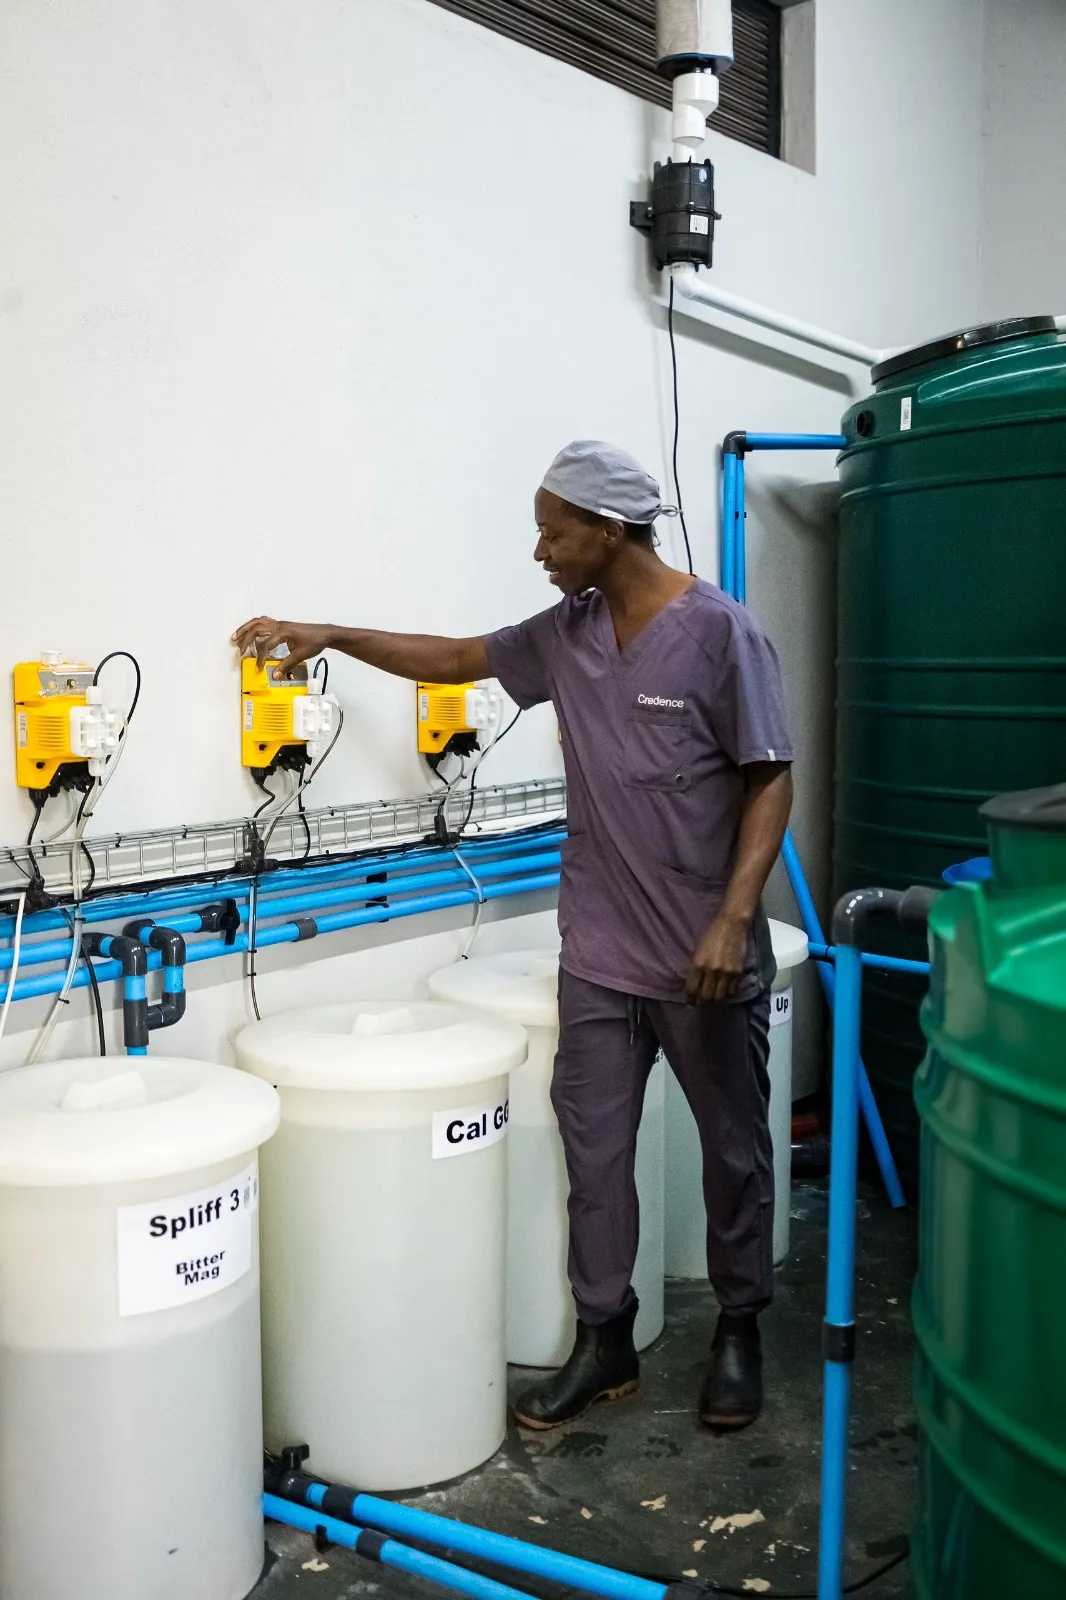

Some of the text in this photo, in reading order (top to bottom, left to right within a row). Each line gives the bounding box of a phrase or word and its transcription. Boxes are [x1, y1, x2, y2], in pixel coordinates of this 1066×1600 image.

[638, 694, 684, 708] Credence
[776, 996, 789, 1014] Up
[446, 1112, 487, 1144] Cal
[149, 1197, 222, 1239] Spliff
[230, 1188, 240, 1212] 3
[176, 1250, 225, 1275] Bitter
[184, 1266, 220, 1285] Mag
